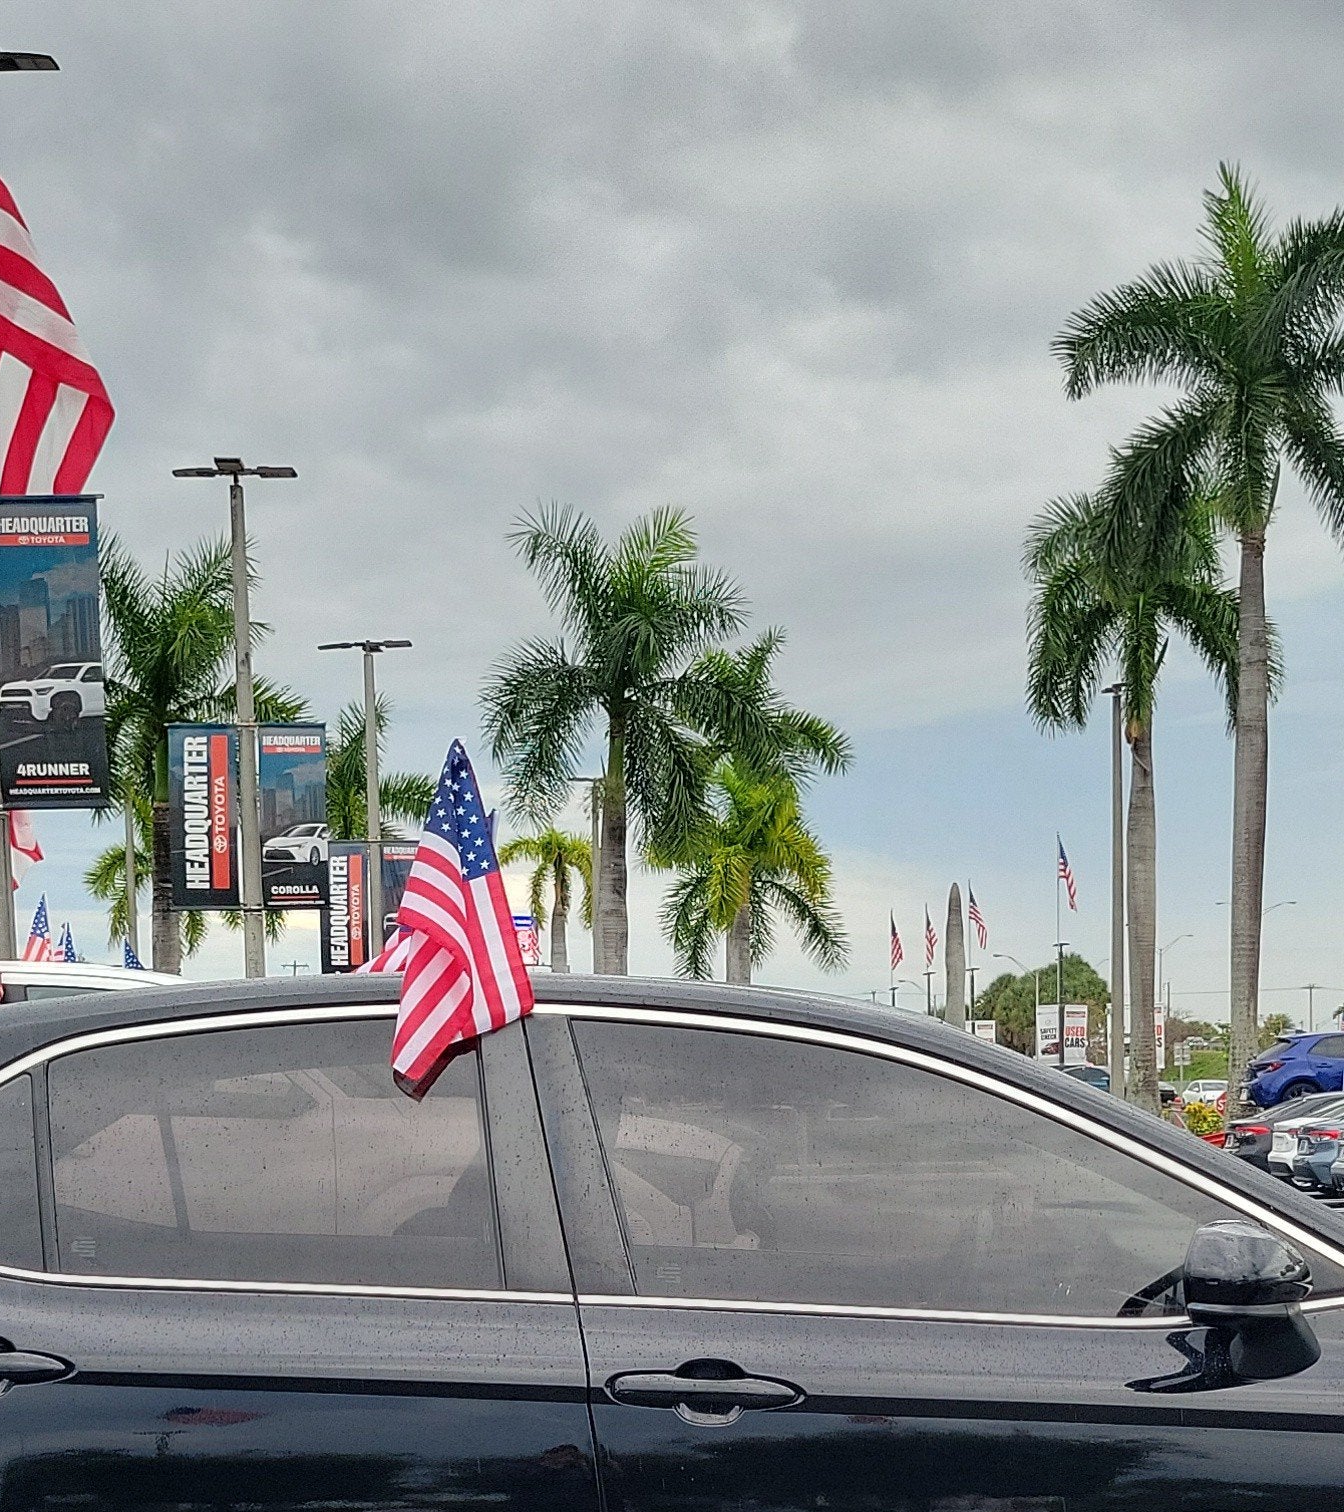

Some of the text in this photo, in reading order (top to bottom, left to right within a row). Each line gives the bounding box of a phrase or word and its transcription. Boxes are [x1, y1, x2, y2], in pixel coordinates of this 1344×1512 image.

[31, 536, 66, 544] TOYOTA
[262, 736, 321, 746] HEADQUARTER
[16, 763, 90, 776] 4RUNNER
[213, 776, 227, 834] TOYOTA
[183, 736, 211, 889] HEADQUARTER
[271, 885, 320, 895] COROLLA
[330, 855, 350, 966] HEADQUARTER
[351, 884, 360, 927] TOYOTA
[1065, 1026, 1085, 1037] USED
[1065, 1037, 1086, 1047] CARS
